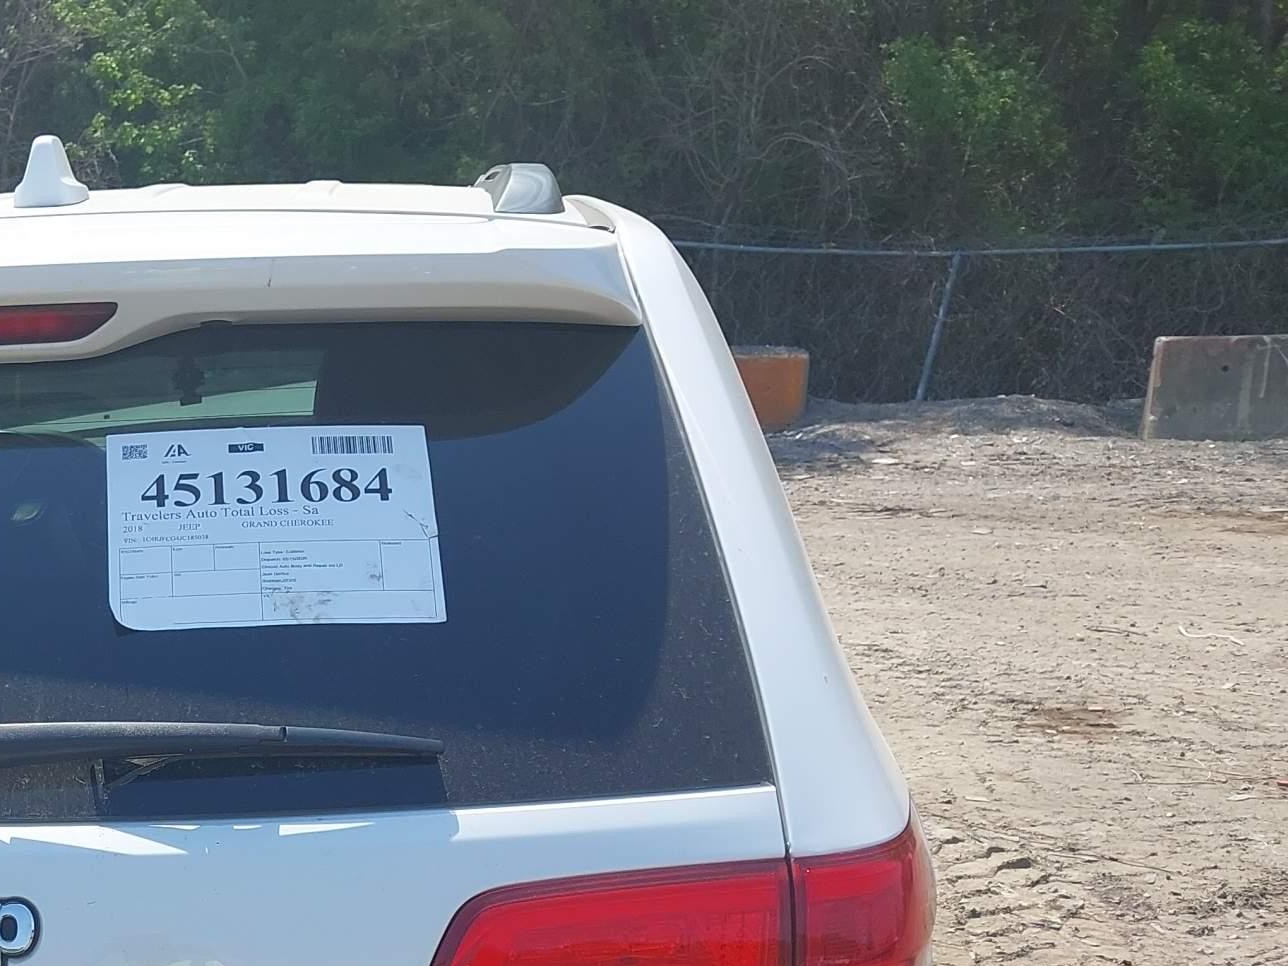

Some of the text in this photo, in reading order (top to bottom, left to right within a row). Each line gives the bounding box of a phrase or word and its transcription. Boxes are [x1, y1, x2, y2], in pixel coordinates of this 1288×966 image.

[237, 443, 255, 451] VIC
[141, 467, 393, 508] 45131684
[121, 509, 182, 522] Travelers
[186, 509, 218, 519] Auto
[221, 506, 255, 517] Total
[259, 505, 289, 516] Loss
[302, 504, 319, 515] Sa
[123, 525, 144, 533] 2018
[241, 520, 278, 529] GRAND
[279, 518, 334, 527] CHEROKEE
